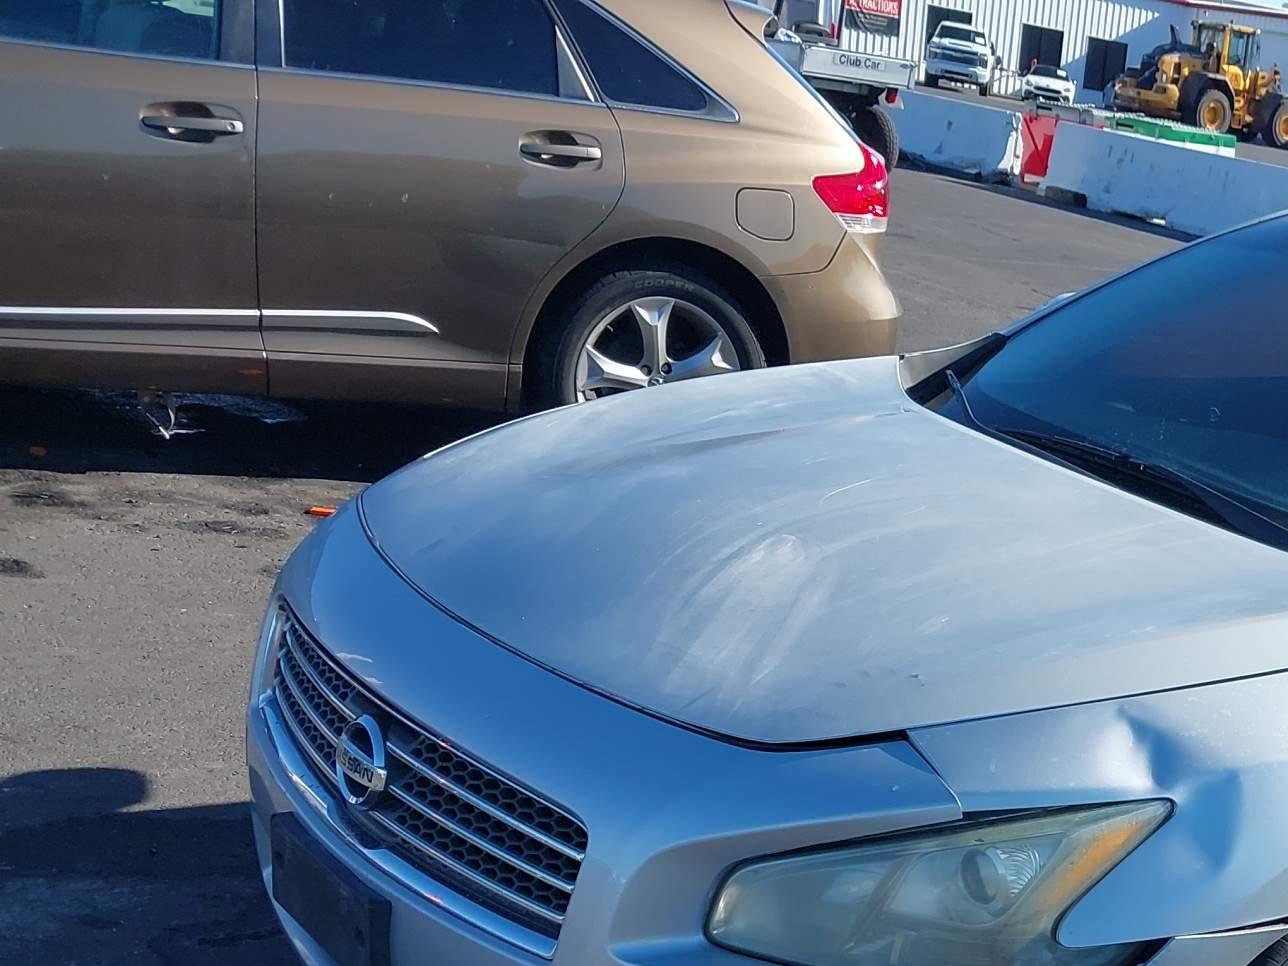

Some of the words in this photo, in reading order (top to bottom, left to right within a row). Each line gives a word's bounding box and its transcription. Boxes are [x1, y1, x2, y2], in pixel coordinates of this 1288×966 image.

[839, 54, 862, 66] Club
[864, 58, 881, 71] Car
[635, 278, 695, 292] COOPER
